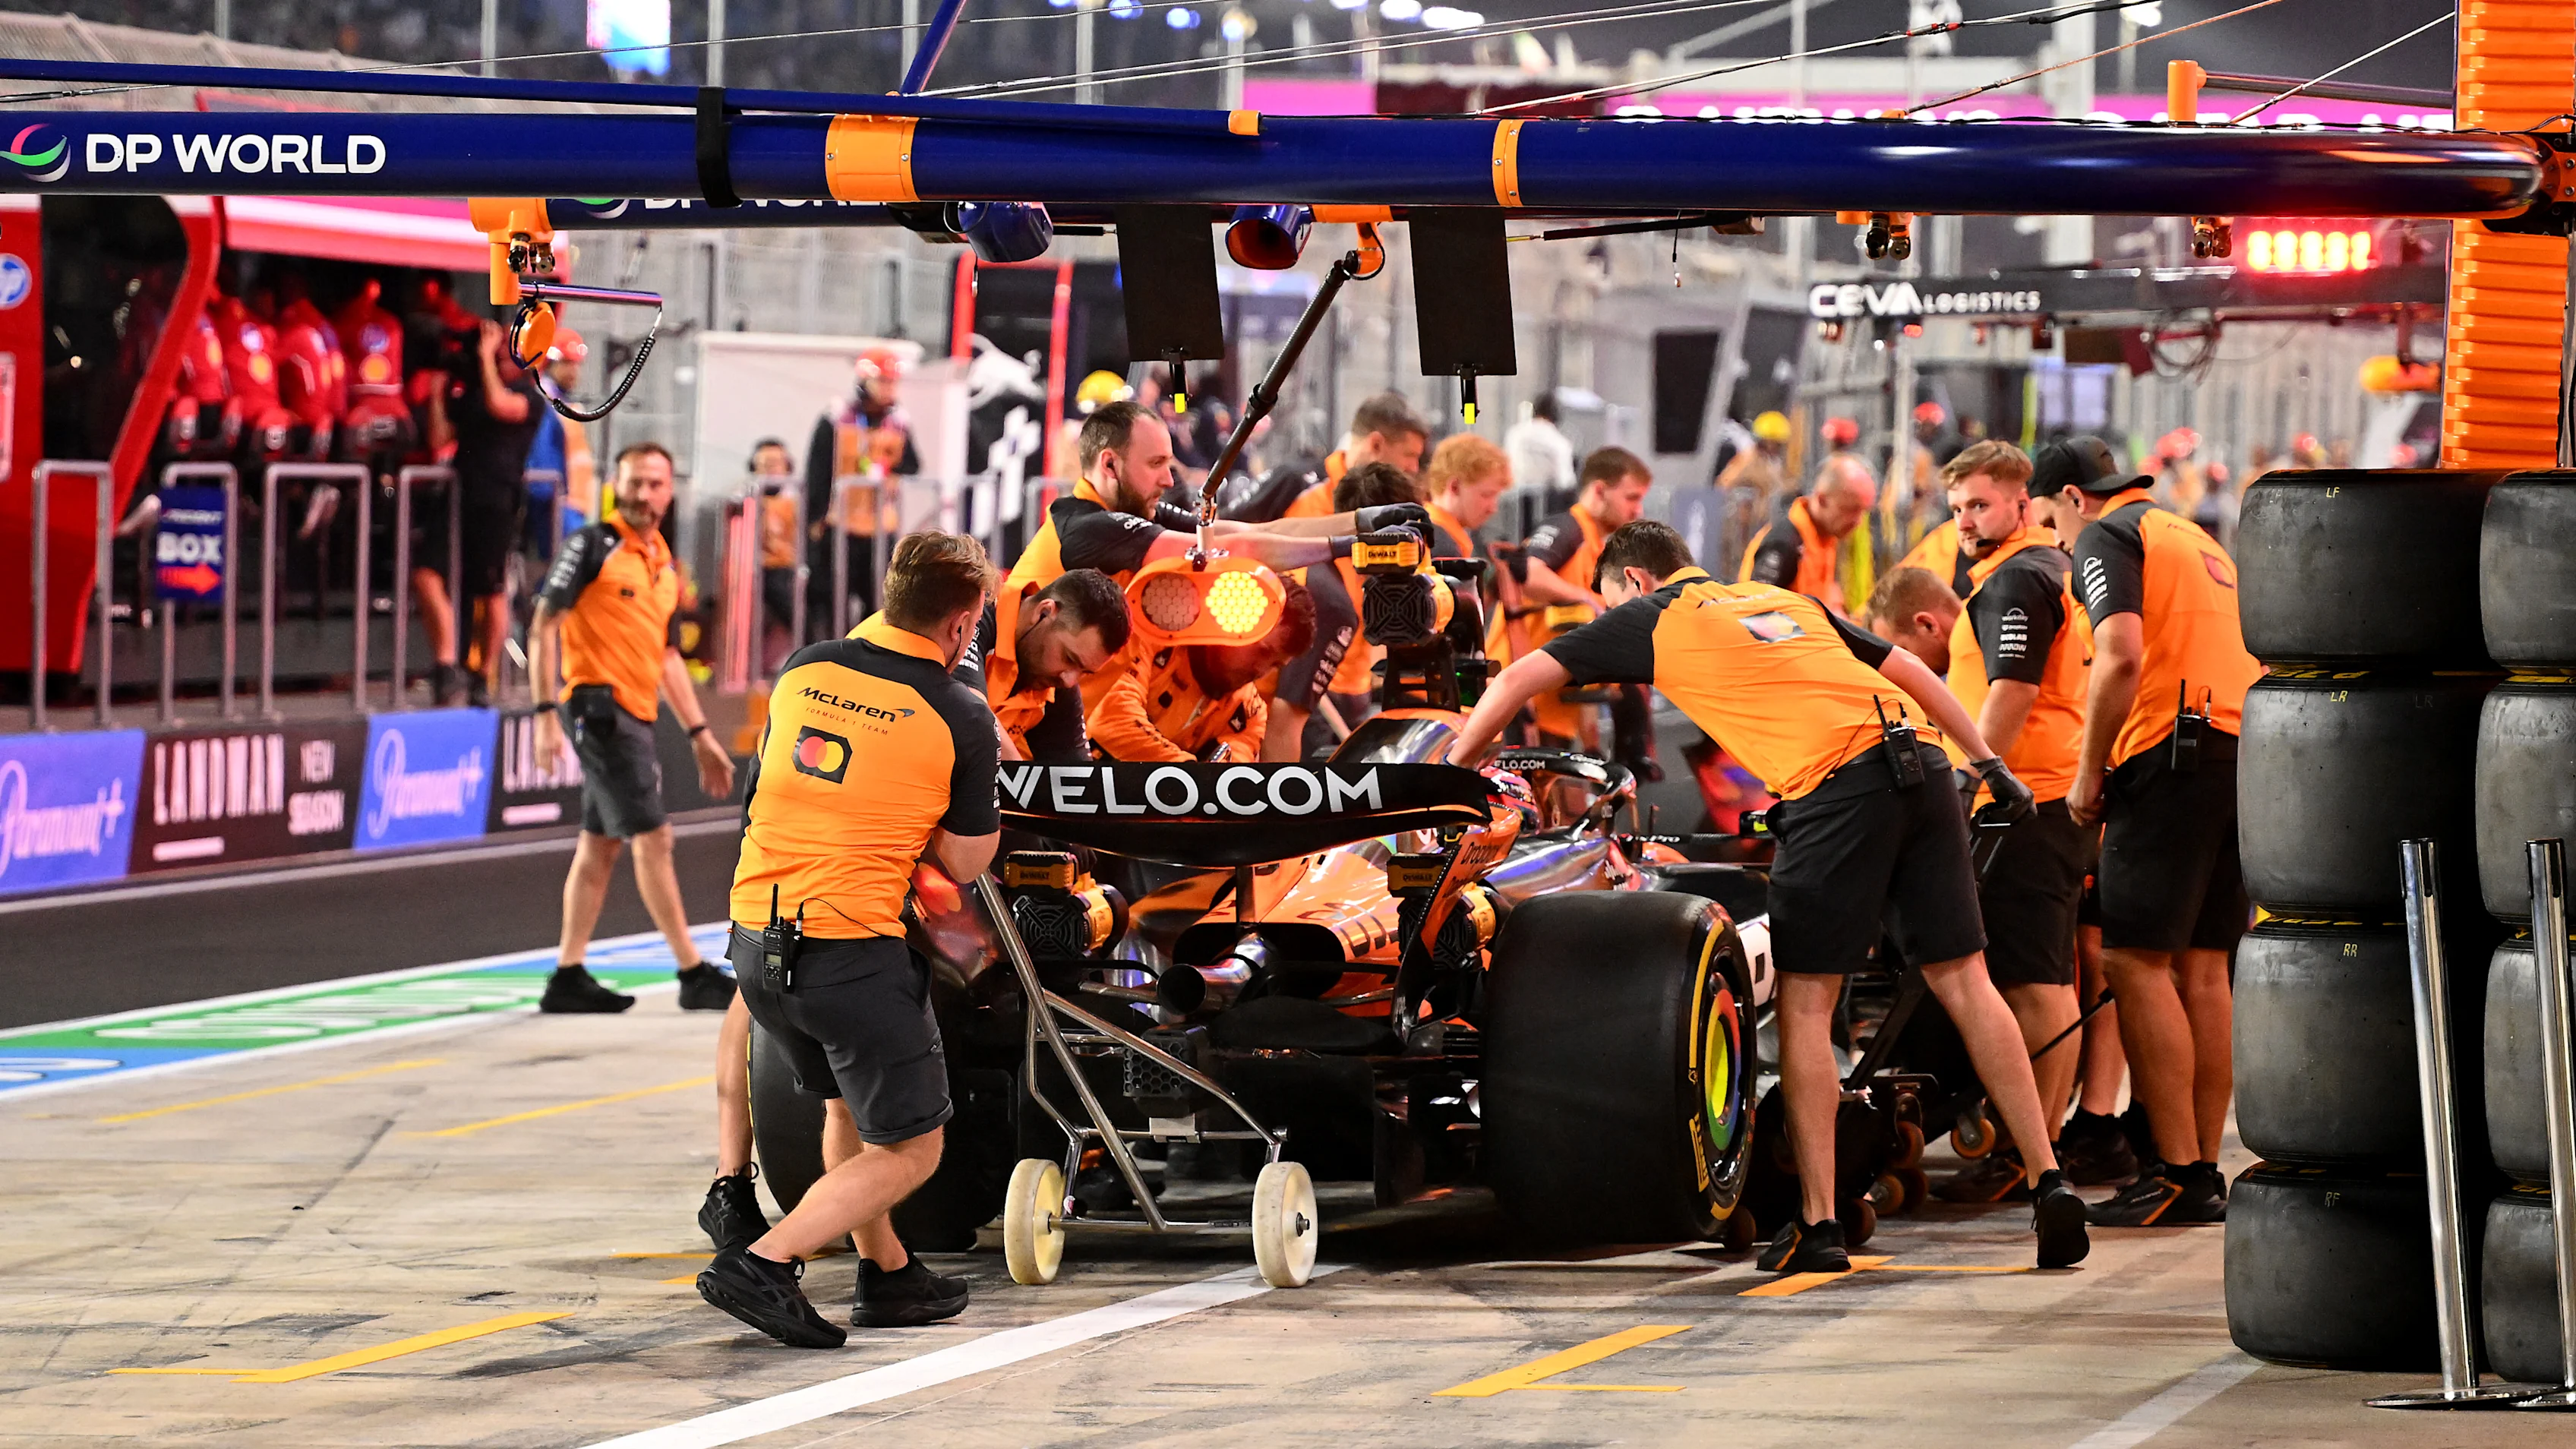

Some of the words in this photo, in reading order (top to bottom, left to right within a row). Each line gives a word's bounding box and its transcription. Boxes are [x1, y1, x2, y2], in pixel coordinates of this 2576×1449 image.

[87, 133, 162, 172] DP
[172, 133, 386, 174] WORLD
[1809, 282, 1923, 317] CEVA
[1923, 290, 2041, 314] LOGISTICS
[2325, 486, 2341, 498] LF
[156, 531, 223, 564] BOX
[796, 687, 896, 723] McLaren
[2331, 690, 2348, 702] LR
[806, 707, 847, 723] FORMULA
[862, 723, 889, 735] TEAM
[998, 766, 1383, 815] VELO.COM
[2343, 942, 2358, 958] RR
[2324, 1192, 2341, 1207] RF
